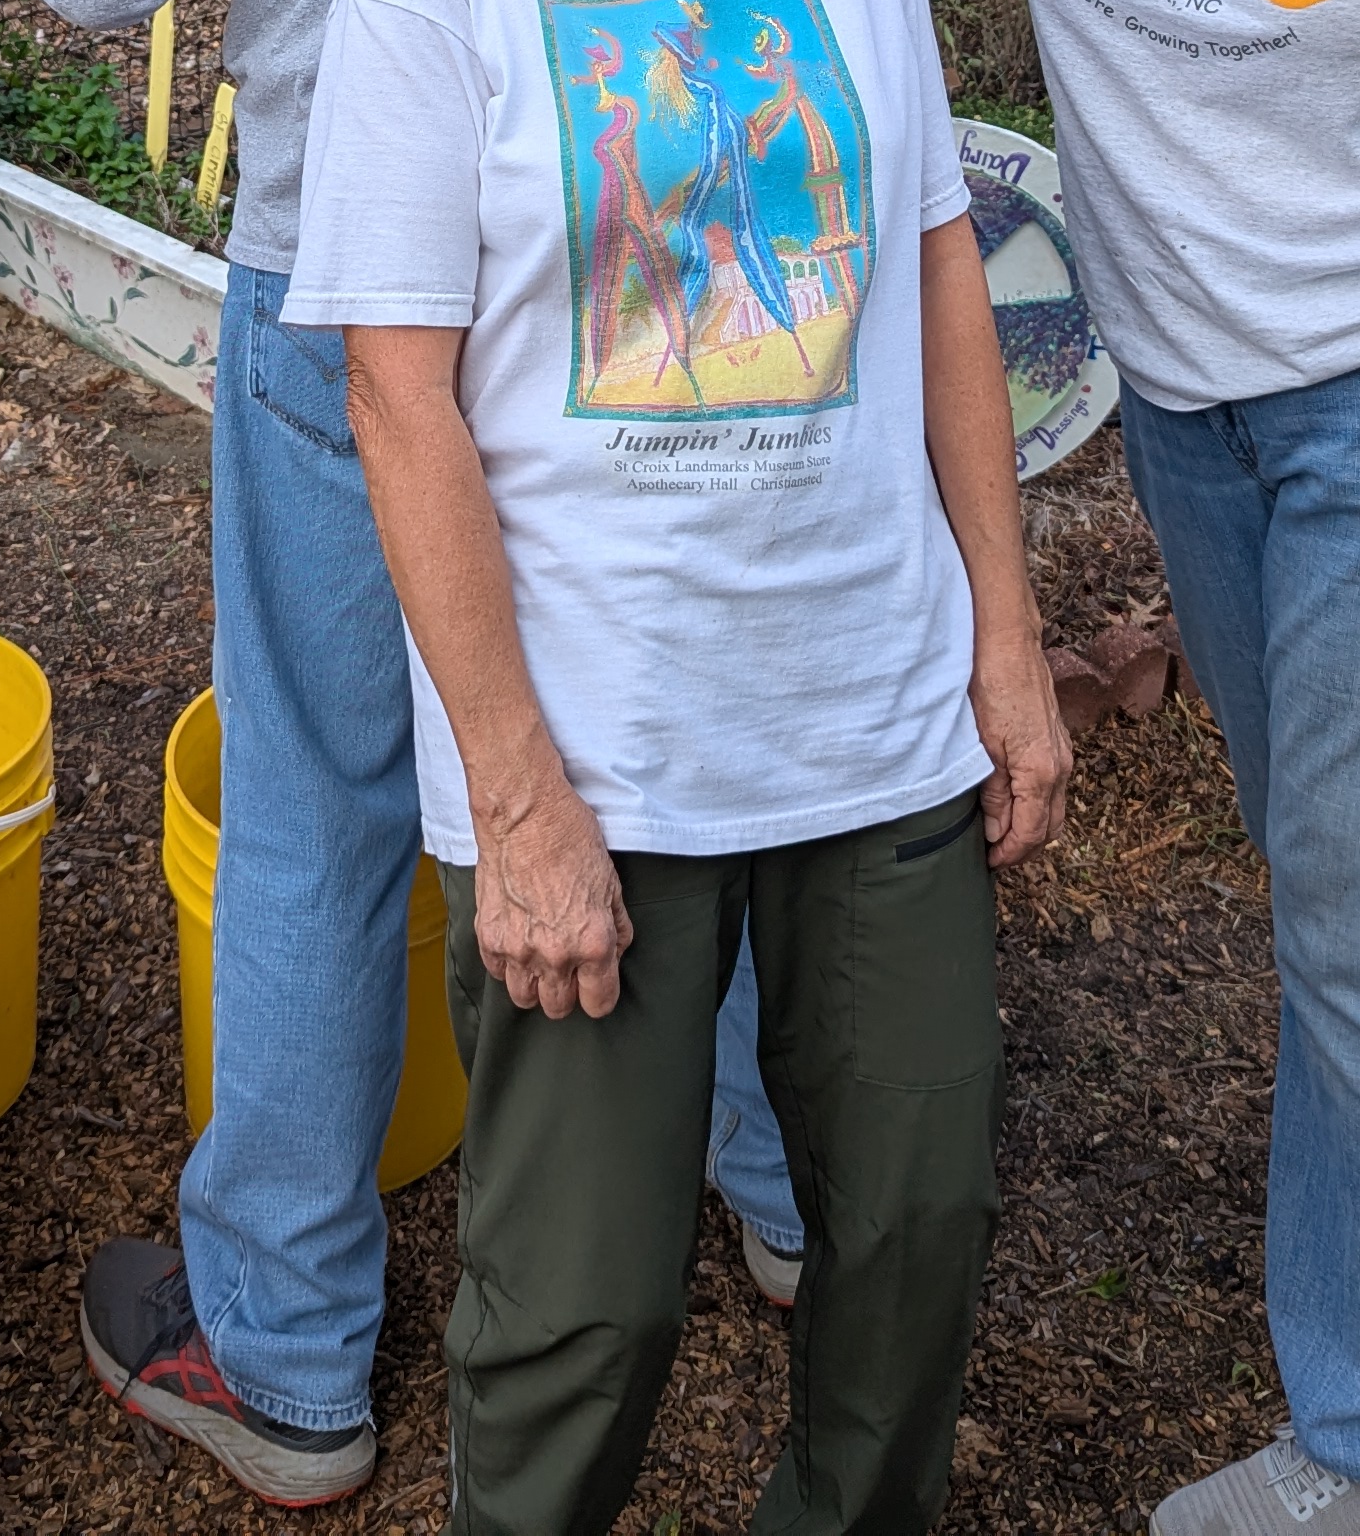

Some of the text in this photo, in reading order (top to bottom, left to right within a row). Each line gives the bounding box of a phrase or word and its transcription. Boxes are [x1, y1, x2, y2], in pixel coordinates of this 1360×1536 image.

[1124, 15, 1199, 58] Growing
[1205, 27, 1301, 61] Together!
[959, 129, 1032, 186] Dairy
[605, 423, 832, 457] Jumpin' Jumbies
[1033, 397, 1090, 451] Dressings
[627, 472, 823, 493] Apothecary Hall Christiansted
[632, 460, 670, 473] Croix
[675, 459, 750, 473] Landmarks
[754, 459, 804, 472] Museum
[806, 455, 831, 469] Store
